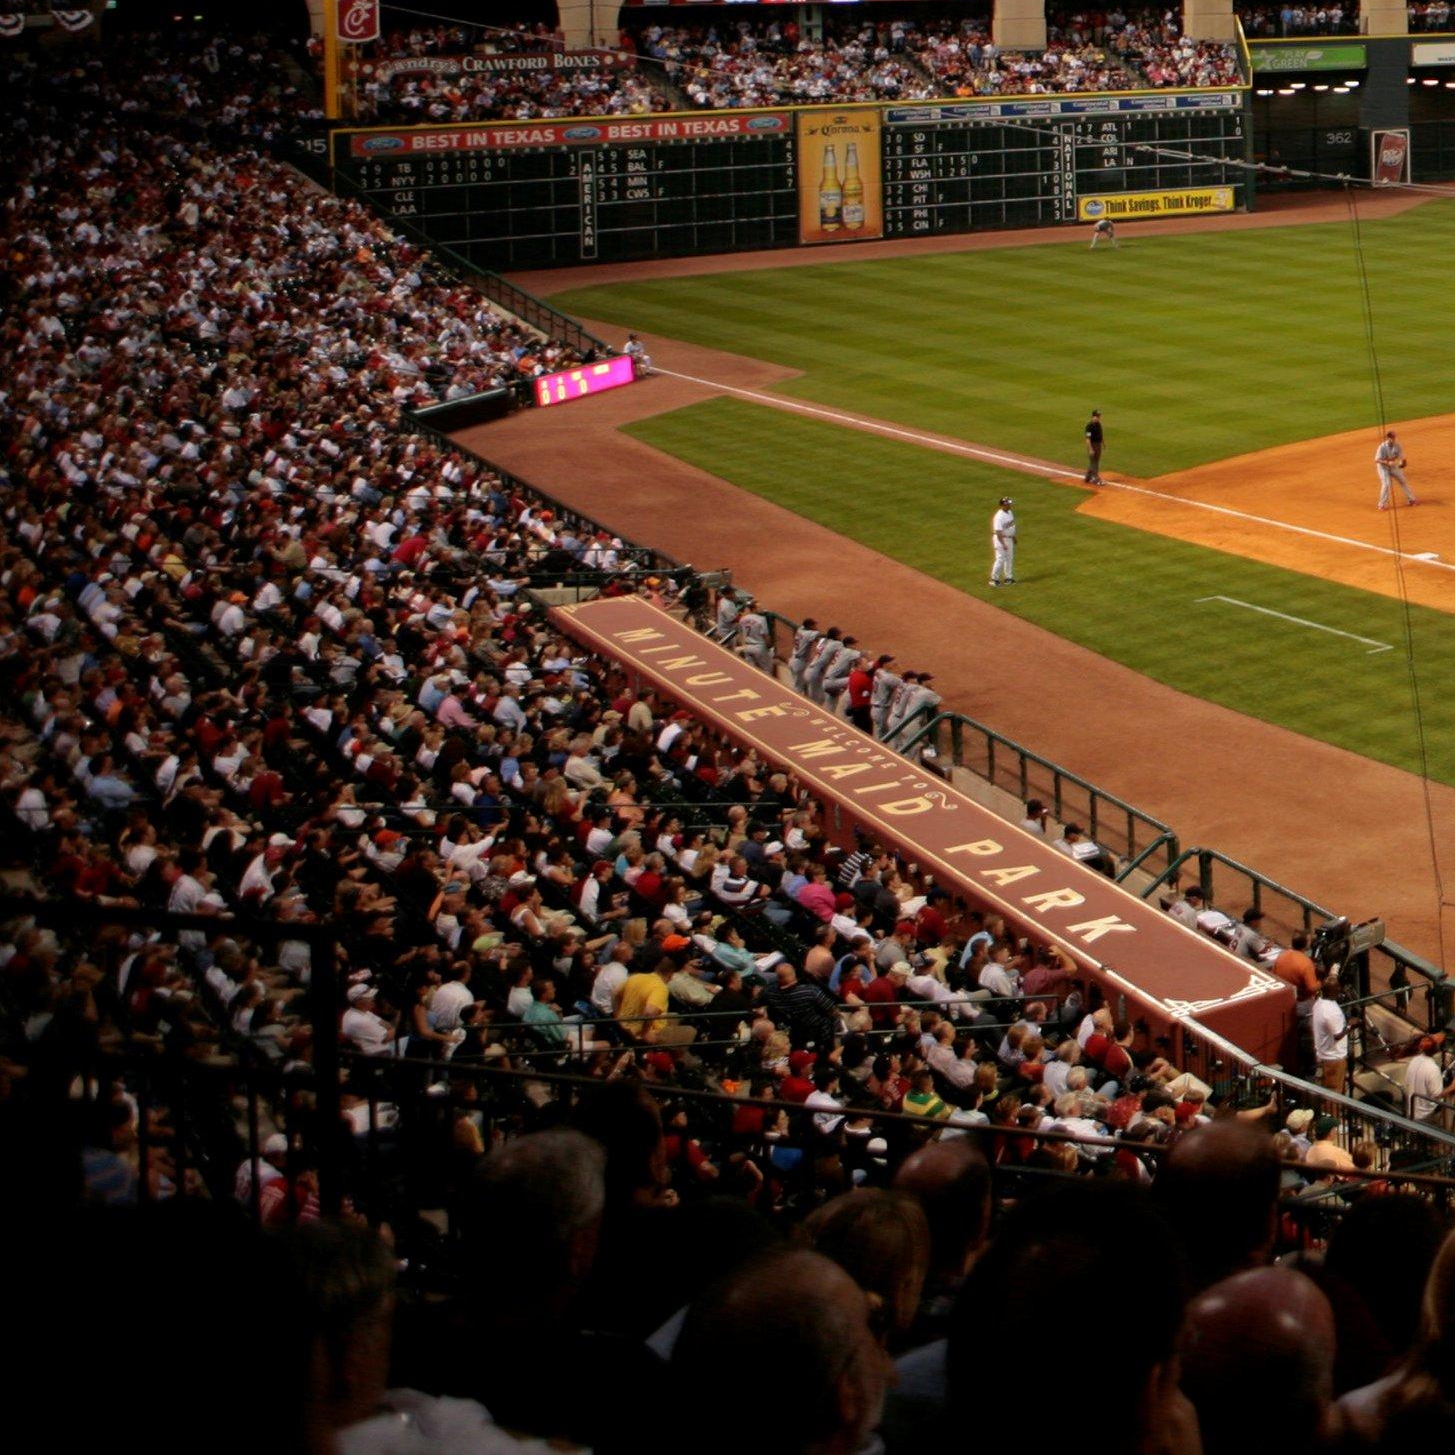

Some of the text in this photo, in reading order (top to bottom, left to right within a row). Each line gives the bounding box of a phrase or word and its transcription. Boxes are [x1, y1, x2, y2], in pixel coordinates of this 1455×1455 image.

[462, 53, 600, 72] CRAWFORD BOXES
[1273, 57, 1308, 69] GREEN
[608, 123, 652, 138] BEST
[657, 122, 677, 136] IN
[683, 119, 740, 136] TEXAS
[1325, 133, 1351, 144] 362
[412, 133, 461, 149] BEST
[466, 132, 488, 147] IN
[493, 129, 556, 145] TEXAS
[1063, 135, 1073, 210] NATIONAL
[582, 162, 594, 248] AMERICAN
[1105, 198, 1127, 214] Think
[1162, 194, 1184, 210] Think
[613, 627, 1137, 943] MINUTE MAID PARK
